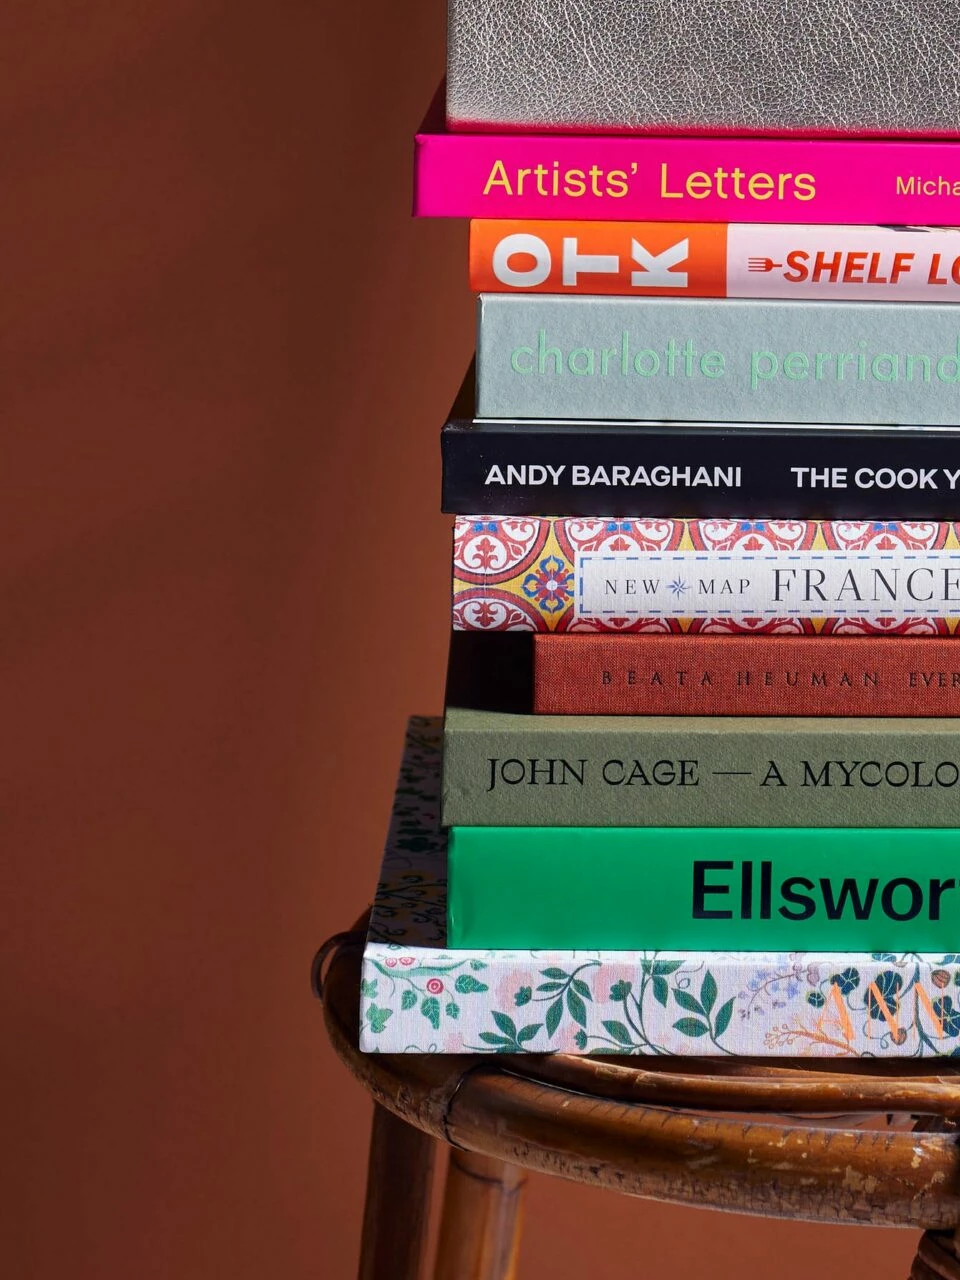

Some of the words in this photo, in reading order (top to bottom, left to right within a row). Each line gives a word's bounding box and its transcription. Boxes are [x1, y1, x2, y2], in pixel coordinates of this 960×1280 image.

[483, 160, 638, 198] Artists’
[660, 163, 816, 200] Letters
[492, 233, 689, 288] OTK
[784, 250, 915, 284] SHELF
[511, 330, 726, 379] charlotte
[485, 465, 566, 485] ANDY
[572, 466, 741, 487] BARAGHANI
[791, 467, 847, 488] THE
[855, 468, 937, 489] COOK
[604, 579, 660, 595] NEW
[698, 579, 751, 595] MAP
[601, 671, 713, 687] BEATA
[736, 672, 881, 688] HEUMAN
[487, 758, 588, 793] JOHN
[602, 759, 700, 787] CAGE
[759, 761, 788, 787] A
